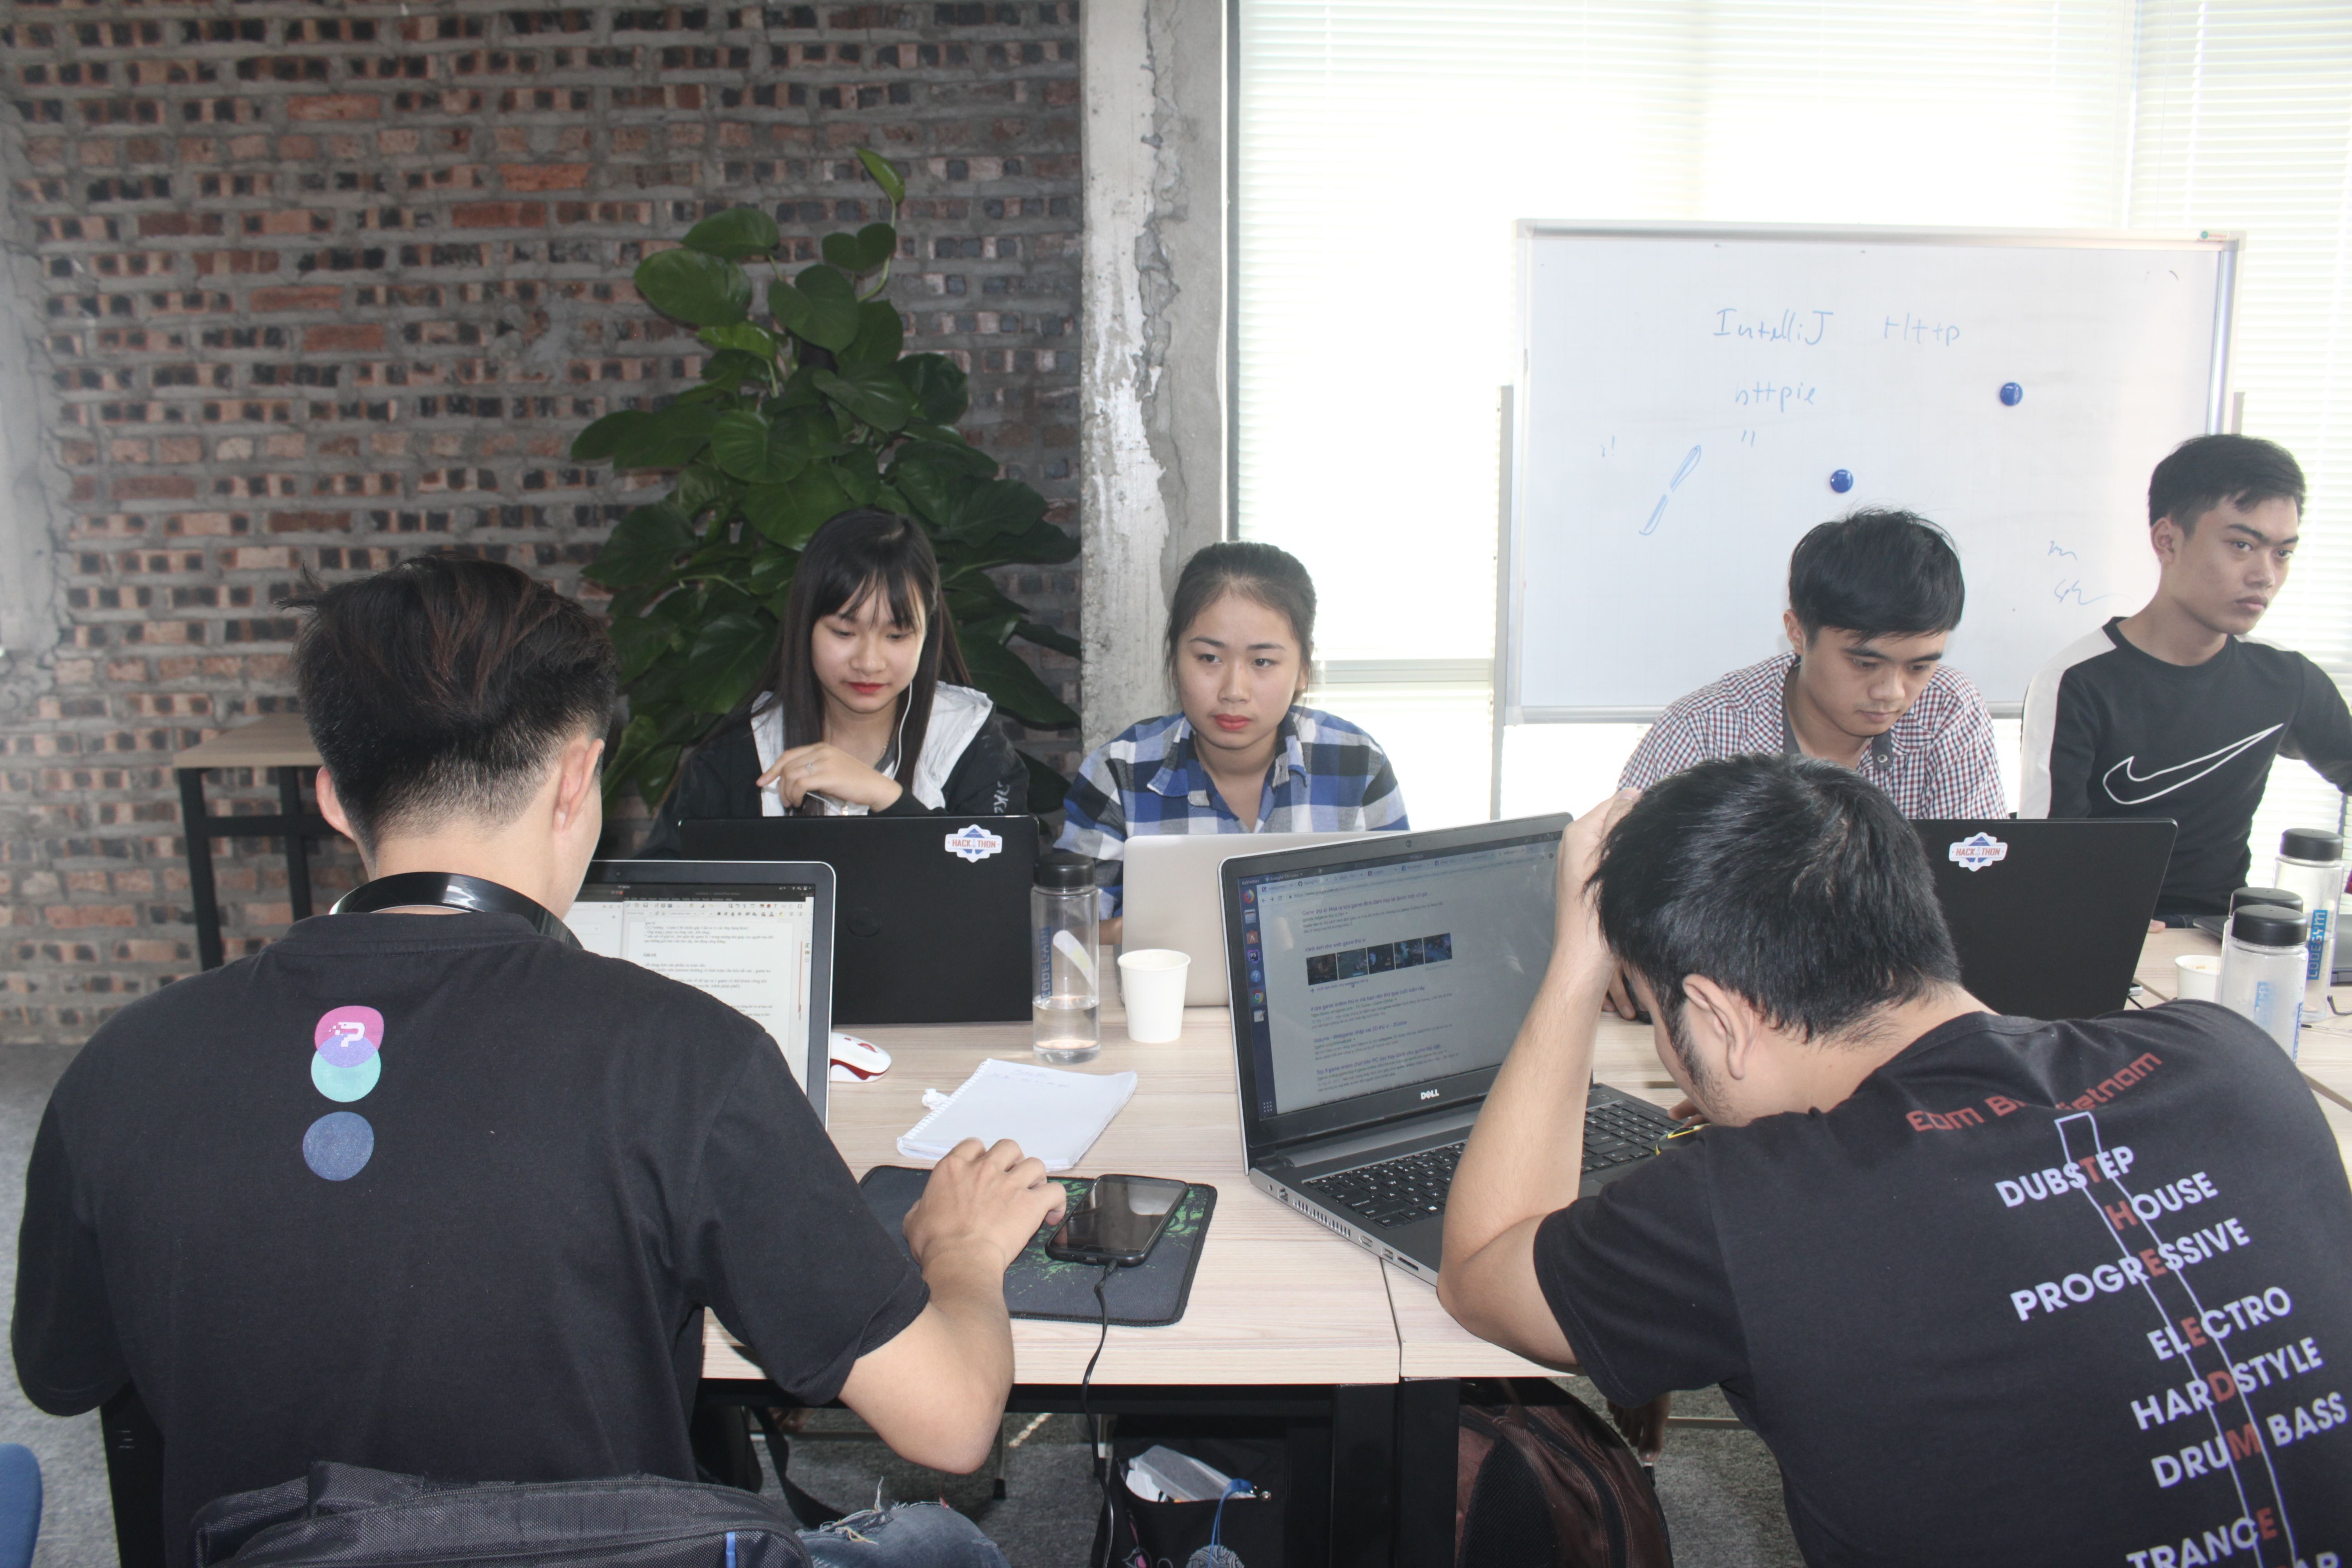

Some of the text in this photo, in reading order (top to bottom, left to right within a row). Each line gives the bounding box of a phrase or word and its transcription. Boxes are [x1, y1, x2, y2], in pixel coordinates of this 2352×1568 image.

[1713, 308, 1834, 345] IntelliJ
[1420, 1089, 1440, 1100] DELL
[1995, 1145, 2135, 1208] DUBSTEP
[2105, 1171, 2219, 1231] HOUSE
[2010, 1217, 2251, 1322] PROGRESSIVE
[2146, 1287, 2293, 1362] ELECTRO
[2130, 1337, 2324, 1431] HARDSTYLE
[2151, 1392, 2348, 1489] DRUM BASS
[2126, 1507, 2278, 1568] TRANCE
